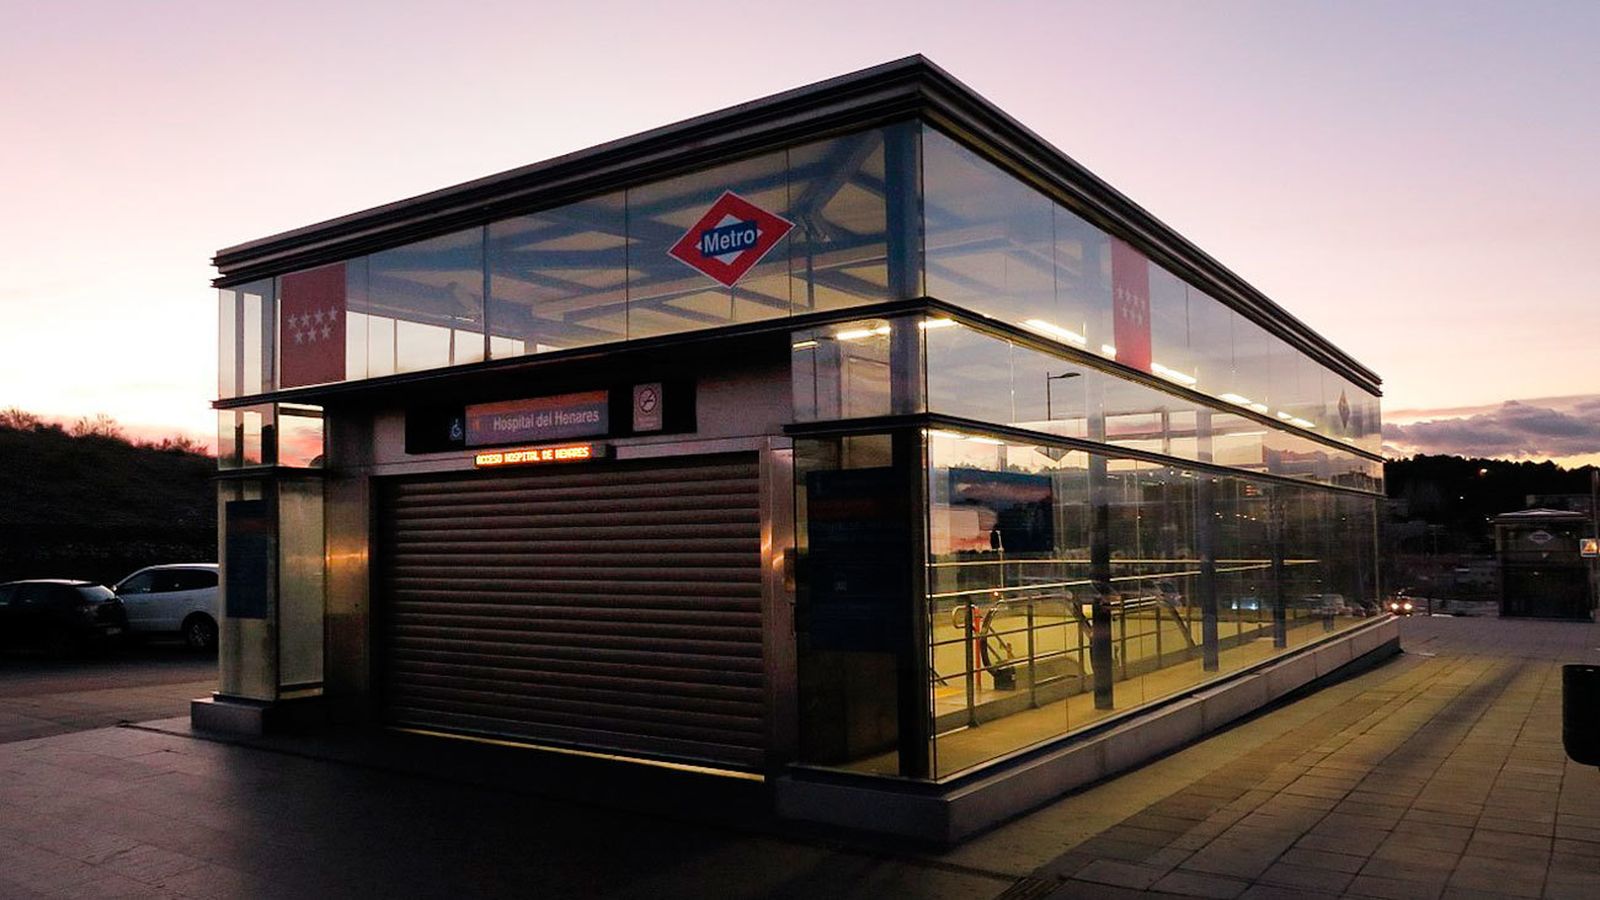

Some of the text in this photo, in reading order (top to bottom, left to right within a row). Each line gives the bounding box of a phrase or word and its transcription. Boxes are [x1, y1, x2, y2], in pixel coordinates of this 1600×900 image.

[703, 228, 756, 254] Metro
[493, 410, 600, 432] Hospital del Henares
[476, 447, 589, 465] ACCESO HOSPITAL DE HENARES
